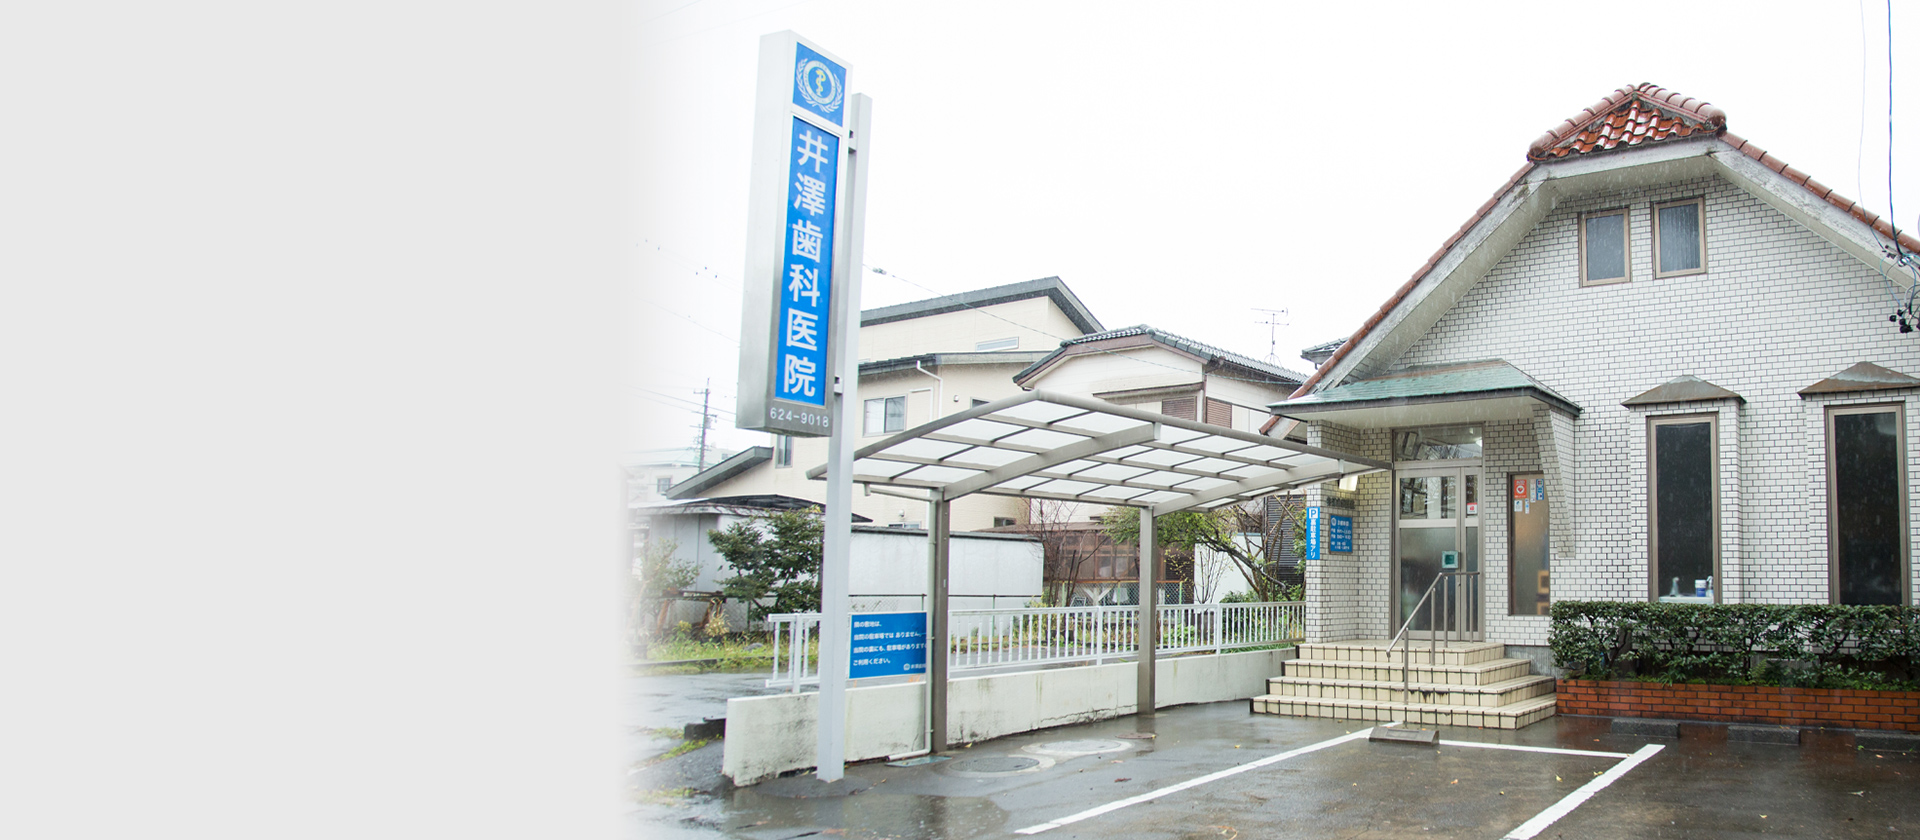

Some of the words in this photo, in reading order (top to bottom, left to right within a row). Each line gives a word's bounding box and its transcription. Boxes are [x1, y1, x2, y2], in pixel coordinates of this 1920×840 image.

[783, 130, 829, 397] 井澤歯科医院
[770, 407, 829, 428] 624-9018
